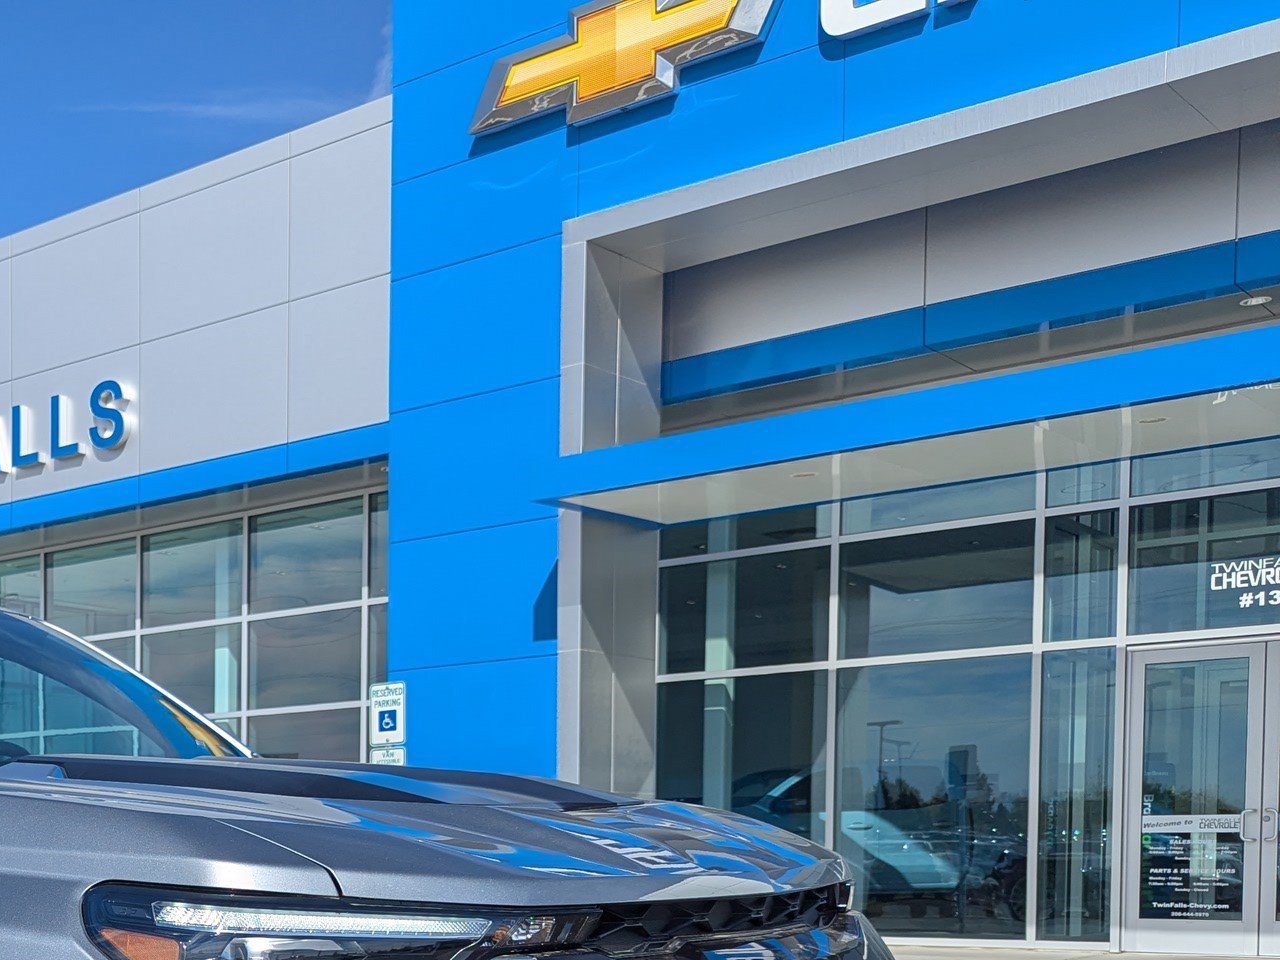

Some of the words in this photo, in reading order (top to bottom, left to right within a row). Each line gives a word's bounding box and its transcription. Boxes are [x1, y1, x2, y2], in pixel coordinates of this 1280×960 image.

[372, 688, 403, 697] RESERVED
[374, 698, 401, 708] PARKING
[1143, 821, 1182, 829] Welcome
